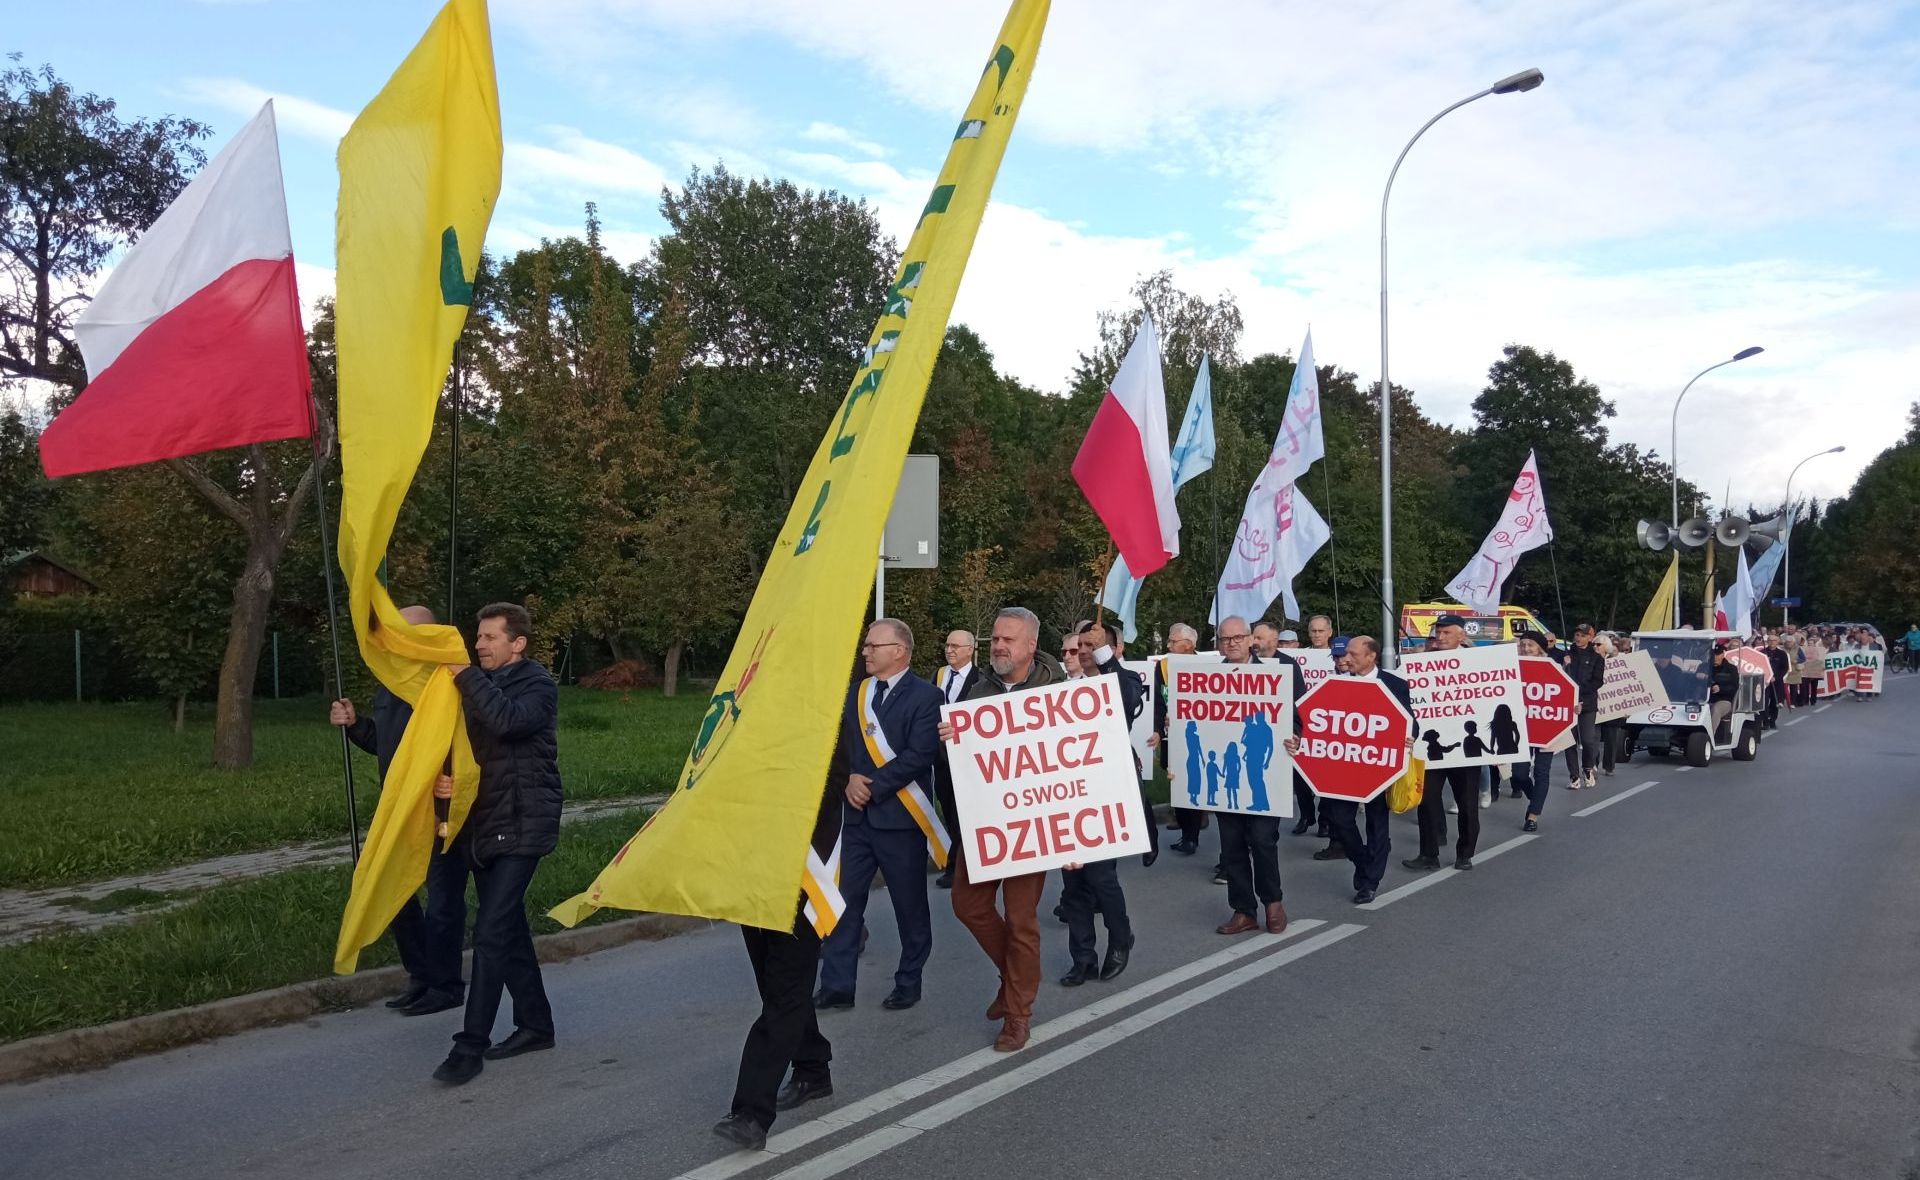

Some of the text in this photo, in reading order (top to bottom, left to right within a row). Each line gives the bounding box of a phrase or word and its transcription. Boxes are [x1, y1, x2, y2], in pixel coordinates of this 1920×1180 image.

[1406, 658, 1461, 674] PRAWO
[1825, 654, 1878, 670] ERACJĄ
[1408, 668, 1517, 690] DO NARODZIN
[1602, 670, 1637, 685] odzinę
[1817, 666, 1875, 694] IFE
[1431, 685, 1506, 703] KAŻDEGO
[1609, 693, 1655, 713] rodzinę!
[949, 682, 1114, 745] POLSKO!
[1176, 699, 1284, 724] RODZINY
[1308, 708, 1389, 738] STOP
[1413, 704, 1475, 719] DZIECKA
[1525, 704, 1569, 721] RCJI
[974, 731, 1103, 783] WALCZ
[1299, 738, 1397, 768] ABORCJI
[1003, 779, 1088, 809] O SWOJE
[975, 802, 1130, 867] DZIECI!
